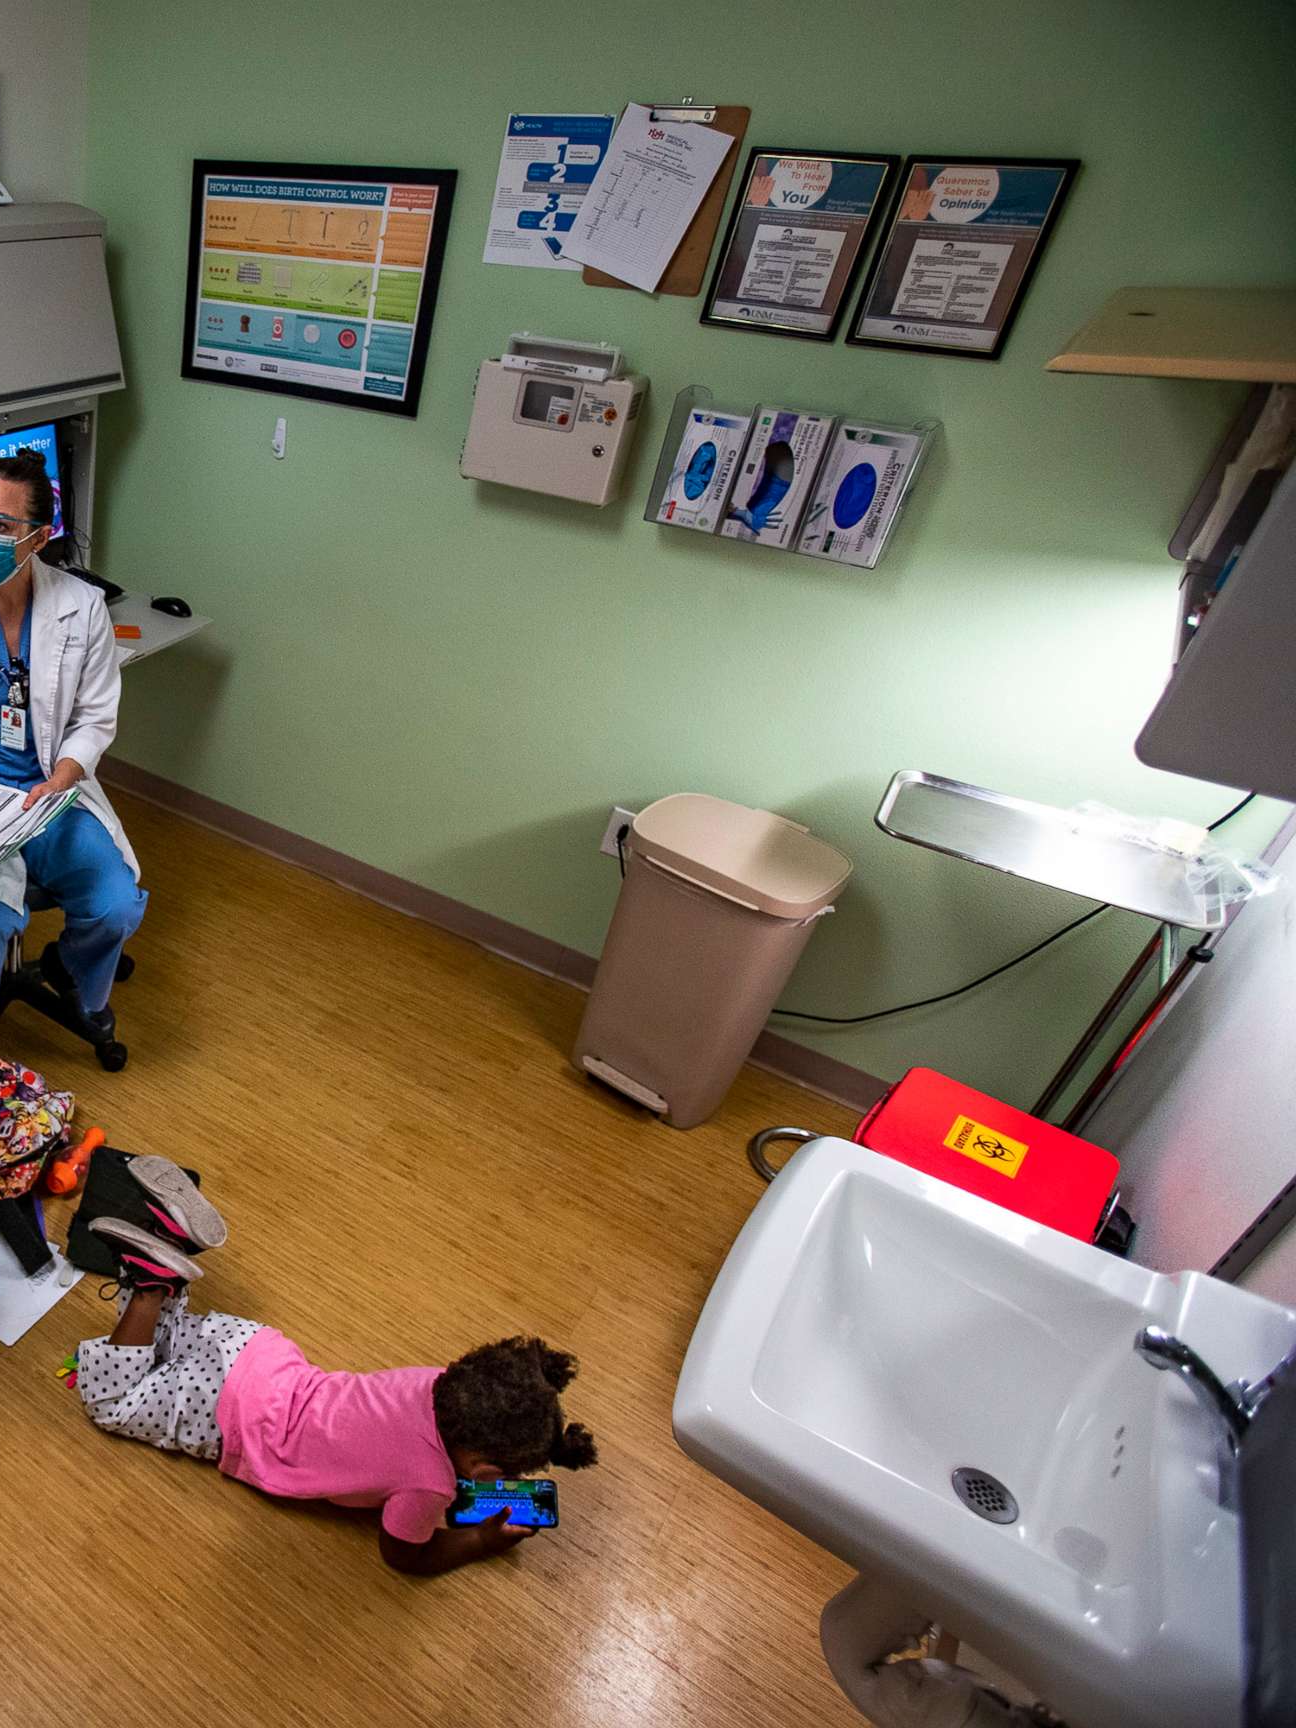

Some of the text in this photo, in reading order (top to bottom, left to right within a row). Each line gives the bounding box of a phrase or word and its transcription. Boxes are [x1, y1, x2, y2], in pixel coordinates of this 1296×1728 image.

[558, 144, 566, 164] 1
[796, 161, 821, 170] Want
[549, 163, 567, 183] 2
[804, 172, 826, 180] Hear
[802, 182, 827, 192] From
[936, 176, 991, 186] Queremos
[208, 183, 385, 202] HOW WELL DOES BIRTH CONTROL WORK?
[782, 190, 810, 204] You
[943, 187, 992, 197] Saber Su
[544, 192, 561, 213] 3
[939, 198, 988, 210] Opinión
[539, 212, 557, 232] 4
[8, 444, 17, 457] it
[712, 449, 737, 501] CRITERION
[876, 462, 901, 514] CRITERION
